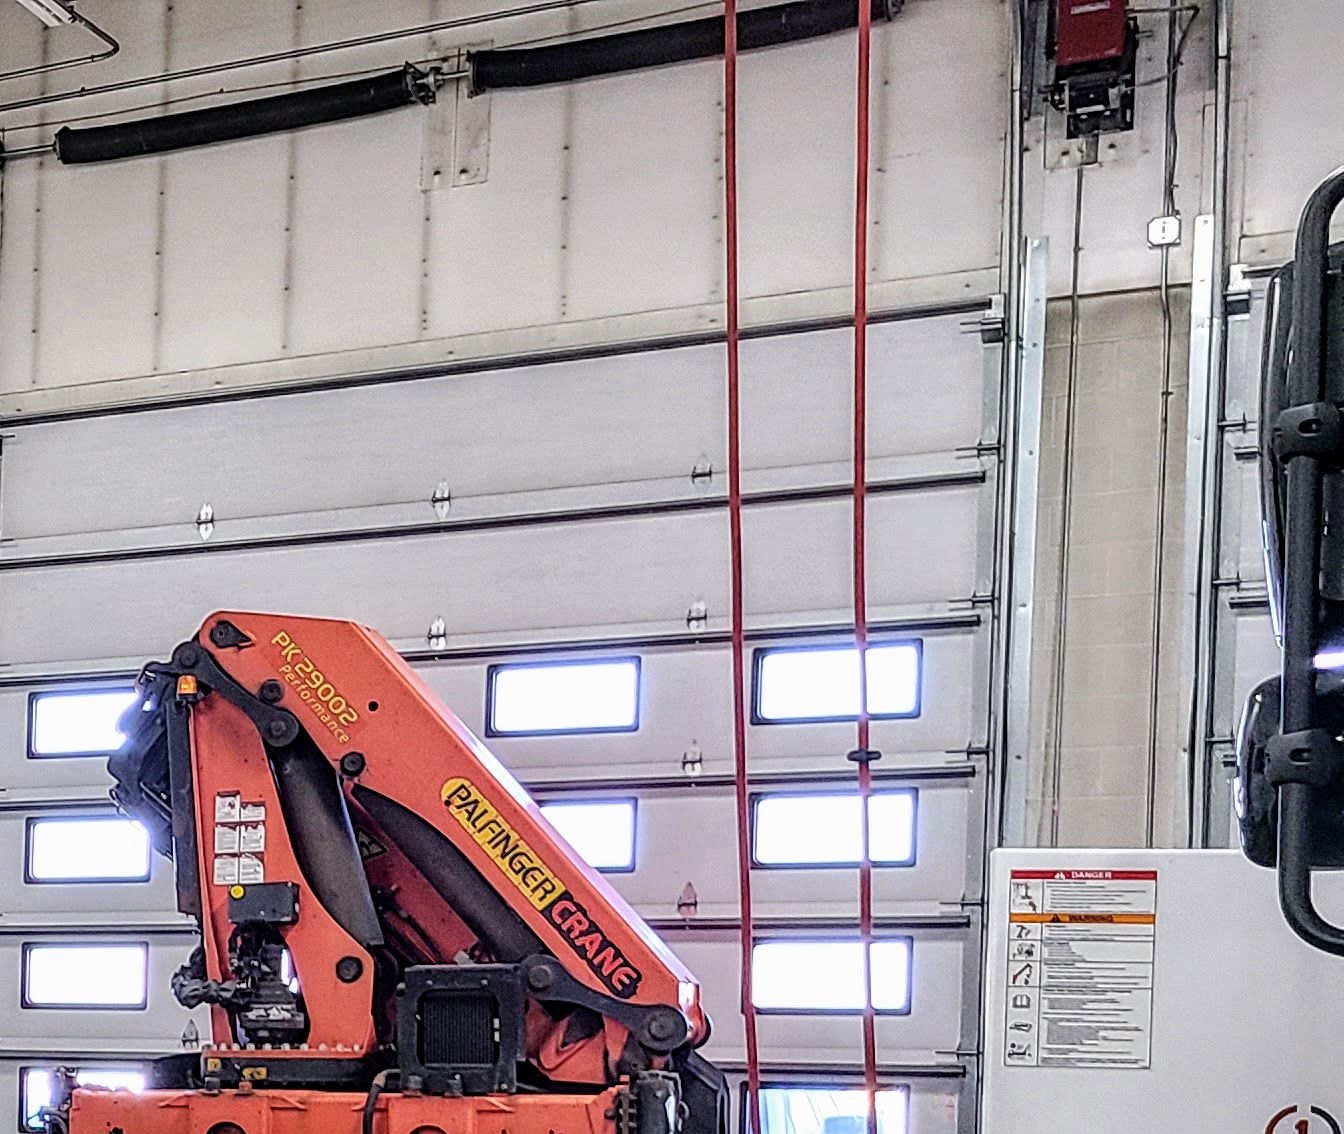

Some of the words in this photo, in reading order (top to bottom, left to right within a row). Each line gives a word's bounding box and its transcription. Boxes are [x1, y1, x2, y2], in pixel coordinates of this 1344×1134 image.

[271, 630, 302, 663] PK
[294, 656, 360, 727] 29002
[278, 664, 350, 744] Performance
[447, 784, 558, 903] PALFINGER
[551, 900, 639, 992] CRANE
[1071, 871, 1112, 879] DANGER
[1068, 914, 1114, 922] WARNING
